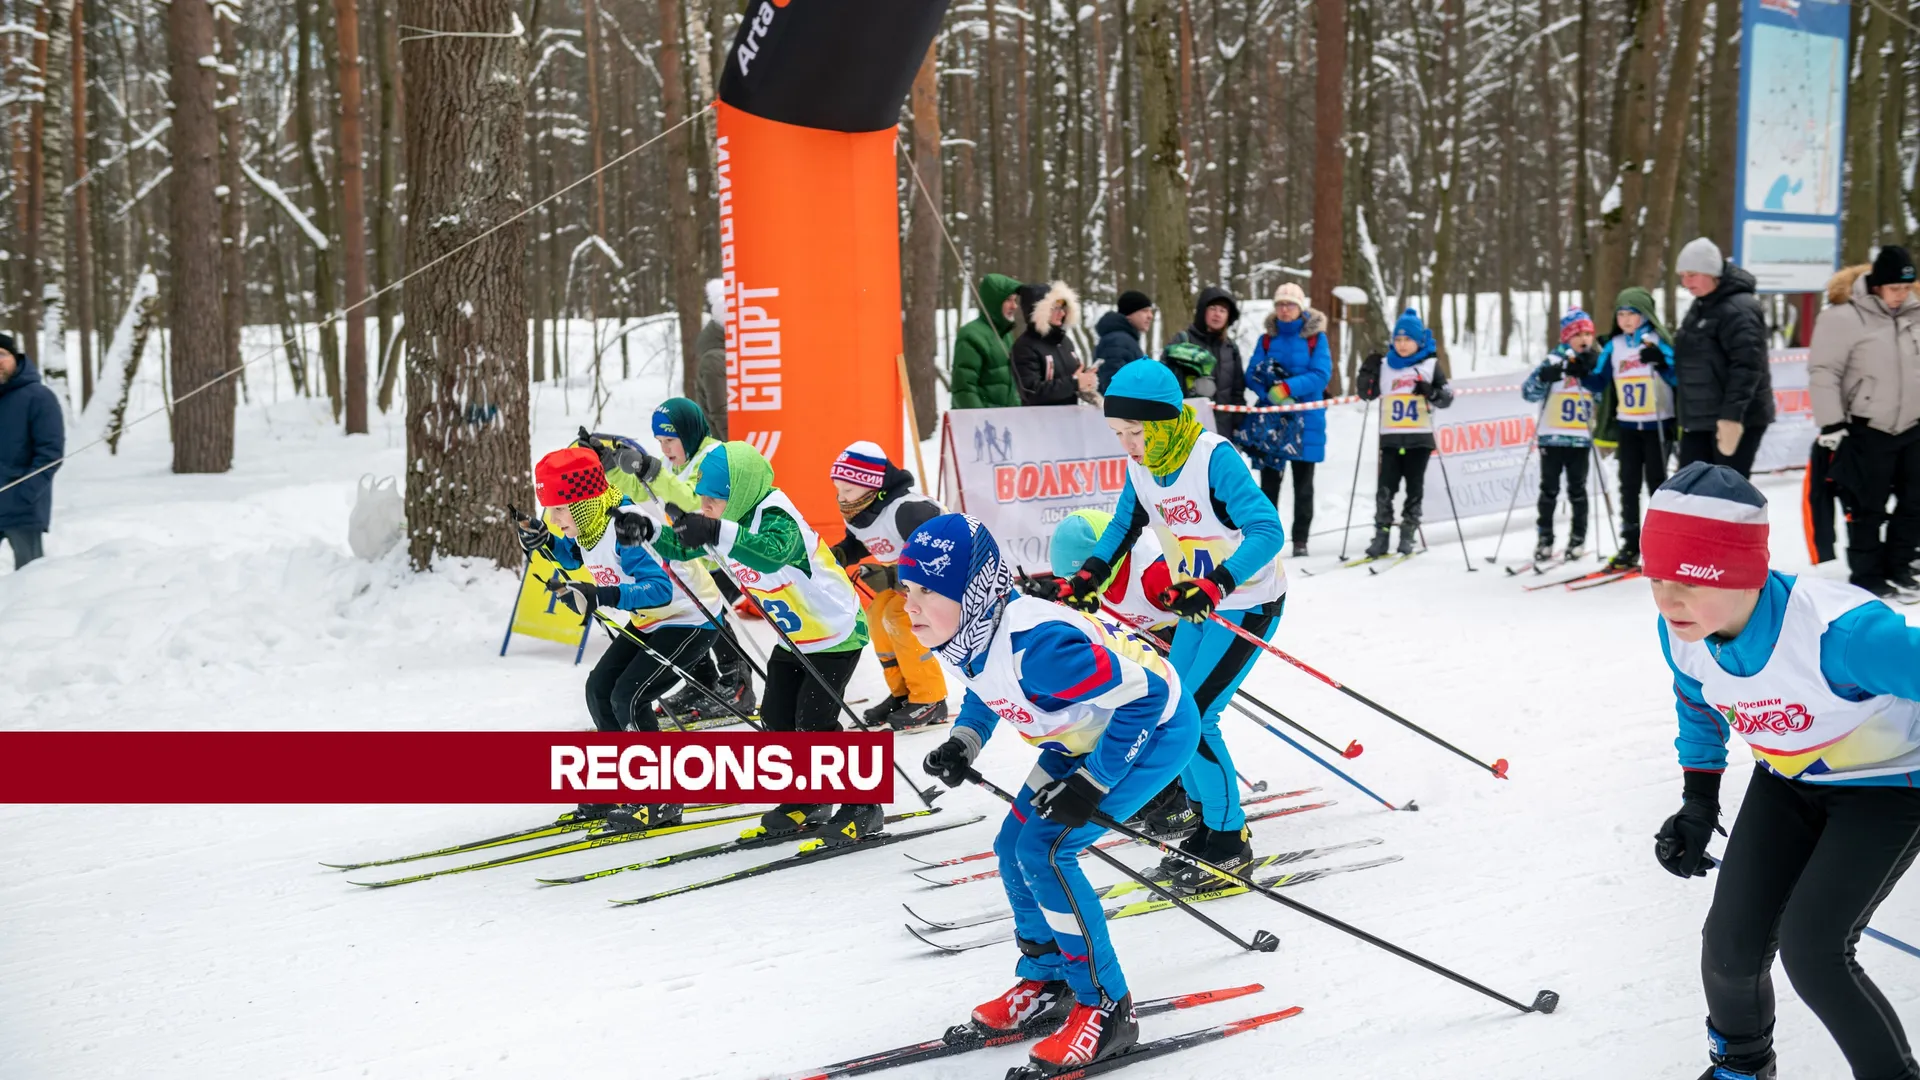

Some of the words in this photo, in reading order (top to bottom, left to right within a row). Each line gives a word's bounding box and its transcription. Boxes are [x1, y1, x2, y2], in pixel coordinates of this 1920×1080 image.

[736, 1, 775, 77] Arta
[737, 282, 782, 411] СПОРТ
[1623, 383, 1646, 408] 87
[1391, 399, 1419, 422] 94
[1561, 398, 1592, 422] 93
[1431, 416, 1537, 456] ОЛКУША
[836, 467, 883, 486] РОССИИ
[994, 456, 1129, 503] ВОЛКУШ
[1737, 698, 1782, 710] орешки
[560, 818, 610, 834] FISCHE
[590, 831, 648, 849] FISCHER
